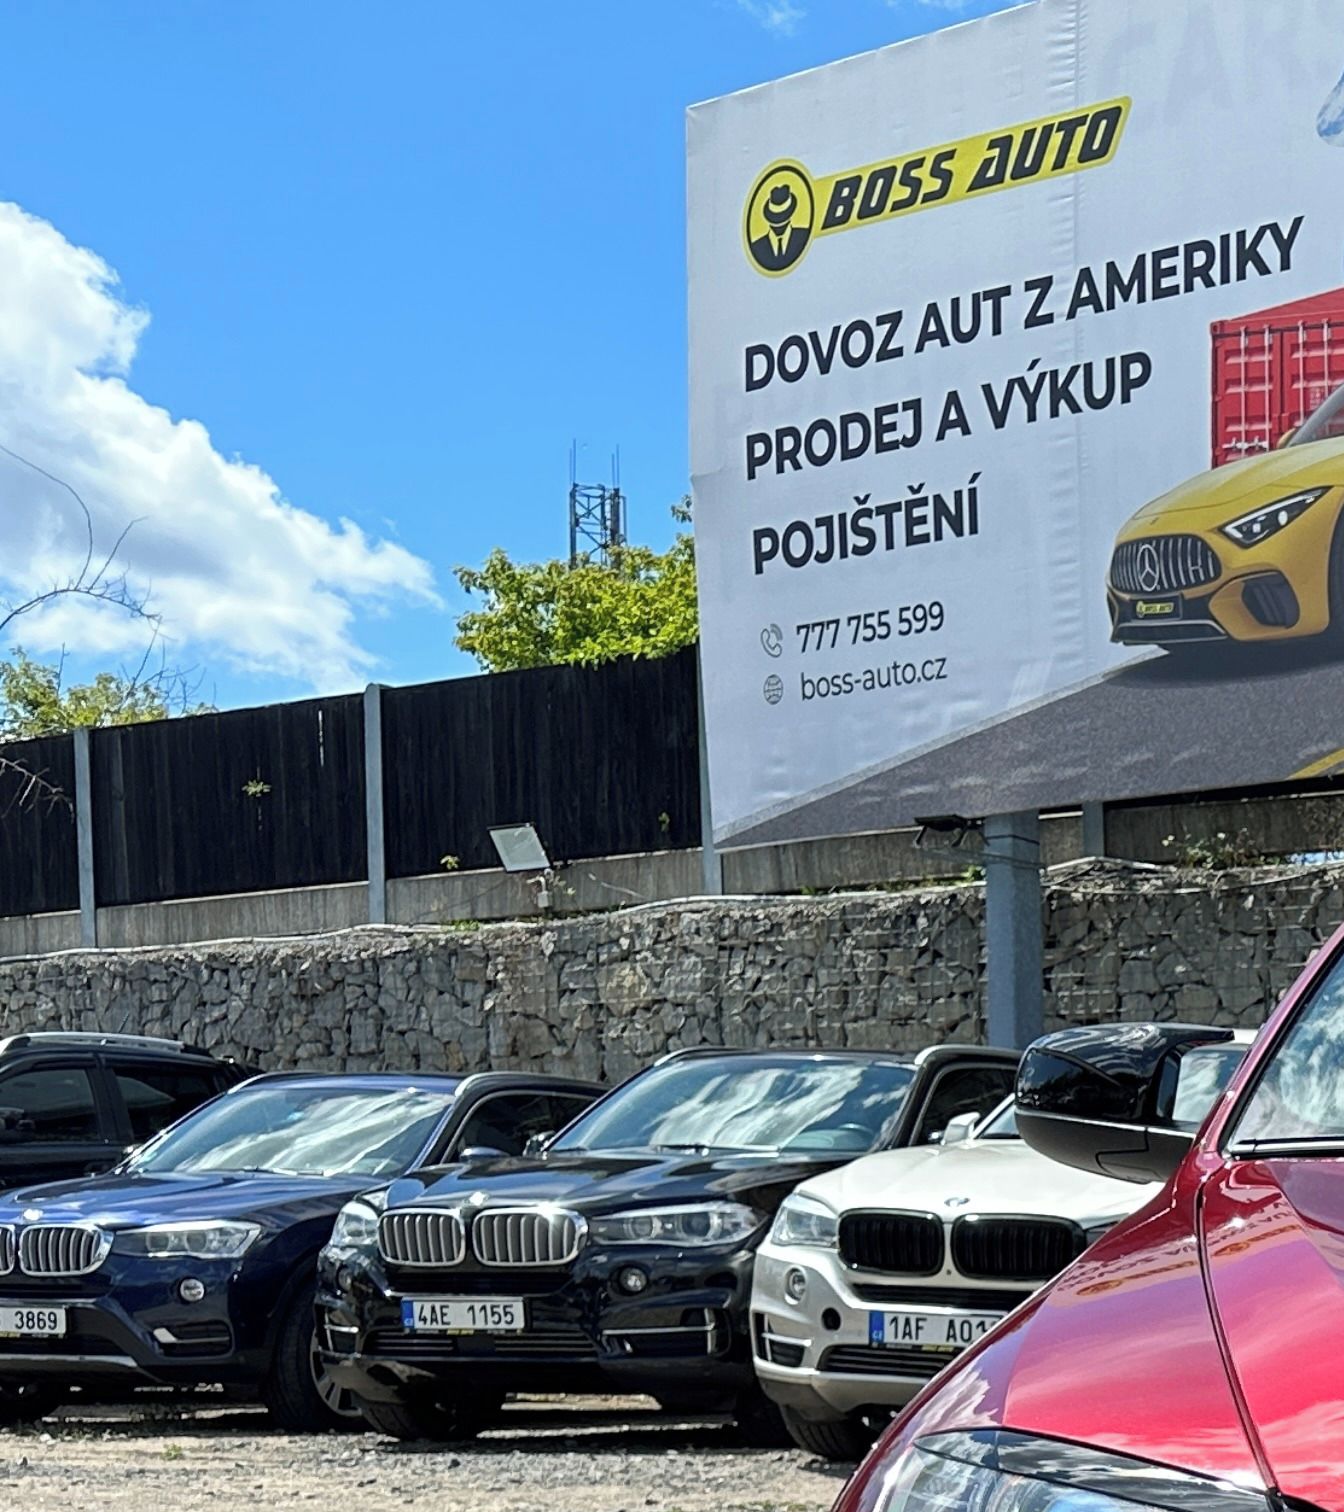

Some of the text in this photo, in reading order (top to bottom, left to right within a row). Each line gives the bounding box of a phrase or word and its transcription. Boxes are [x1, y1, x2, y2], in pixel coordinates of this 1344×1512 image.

[820, 105, 1123, 231] BOSS AUTO
[744, 216, 1305, 392] DOVOZ AUT Z AMERIKY
[745, 351, 1153, 481] PRODEJ A VÝKUP
[752, 472, 982, 575] POJIŠTĚNÍ
[797, 601, 945, 652] 777 755 599
[800, 656, 948, 702] boss-auto.cz
[14, 1310, 58, 1331] 3869
[418, 1304, 514, 1326] 4AE 1155
[889, 1316, 927, 1341] 1AF
